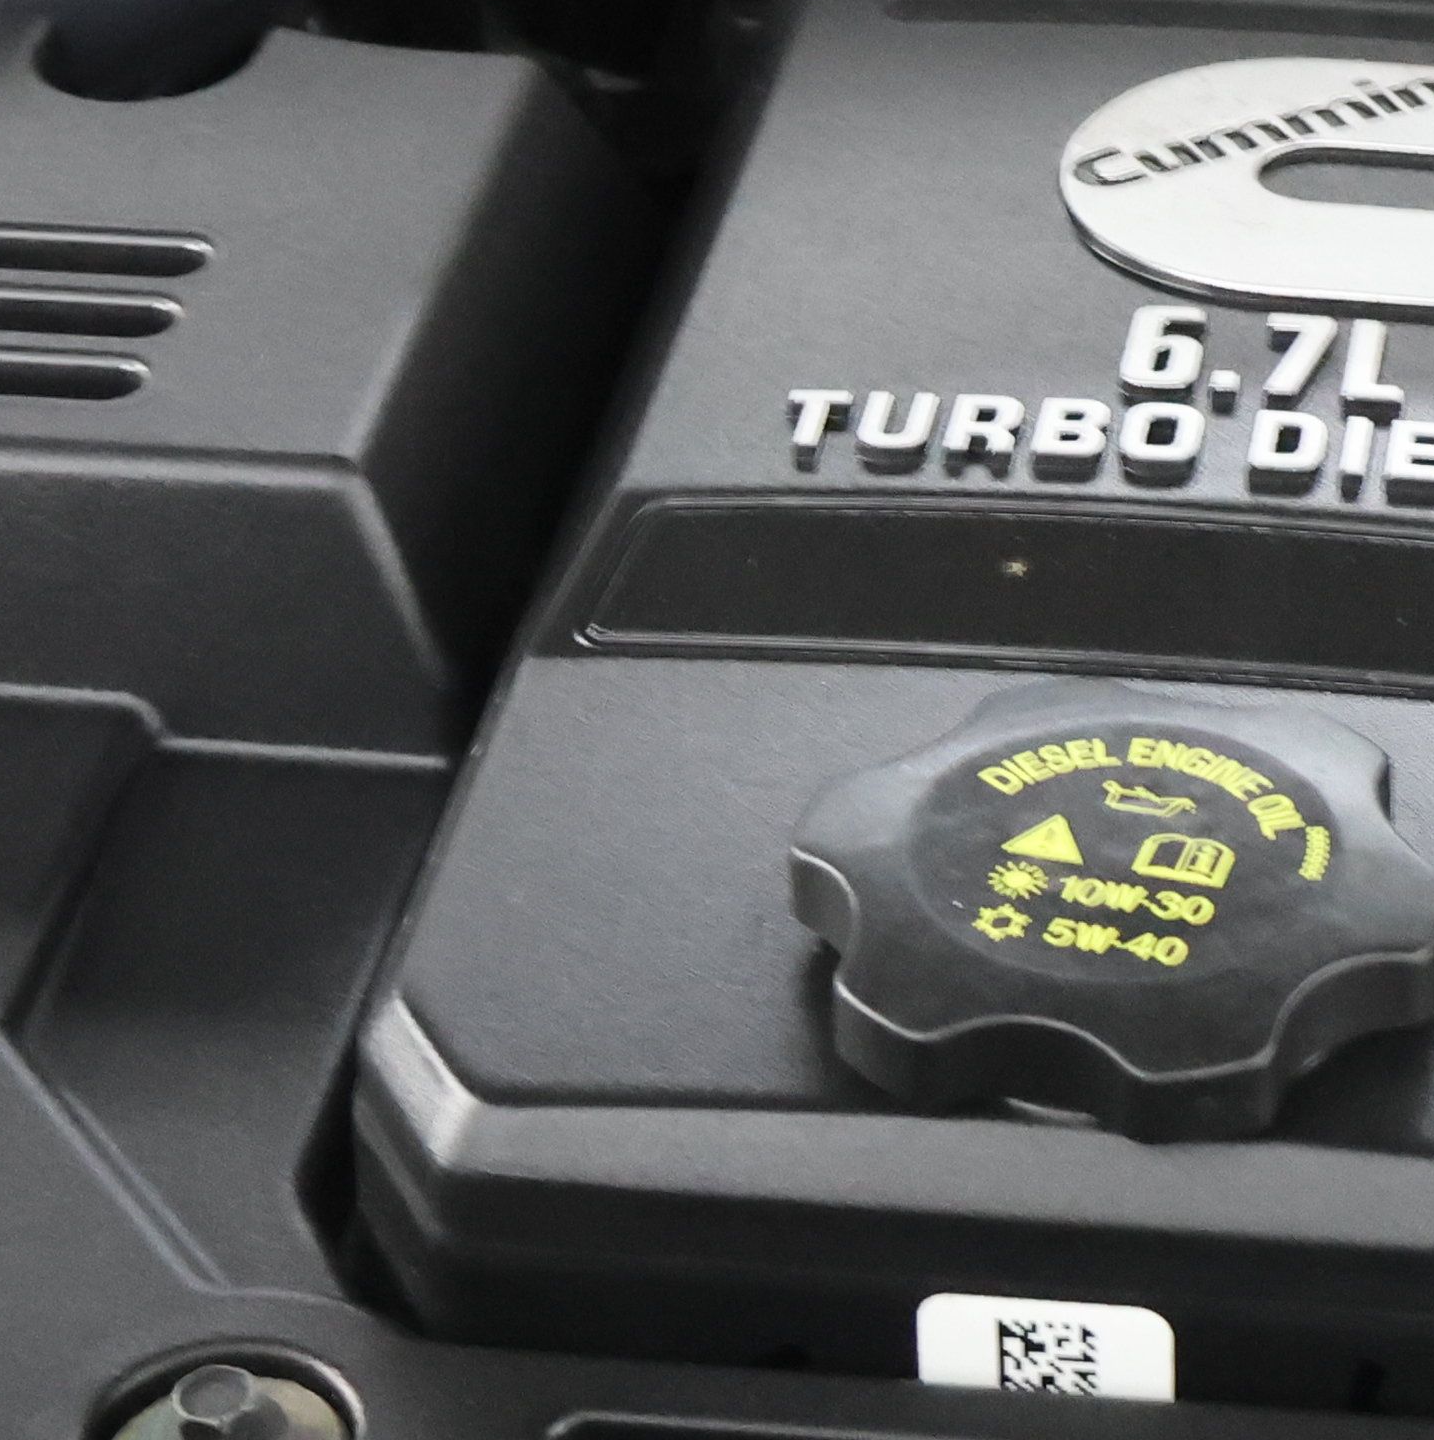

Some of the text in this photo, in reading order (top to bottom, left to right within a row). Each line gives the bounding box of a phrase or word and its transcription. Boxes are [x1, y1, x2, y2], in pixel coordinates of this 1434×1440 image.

[1119, 304, 1405, 401] 6.7L
[787, 388, 1206, 462] TURBO
[977, 737, 1307, 841] DIESEL ENGINE OIL
[1059, 874, 1215, 926] 10W-30
[1042, 916, 1189, 967] 5W-40
